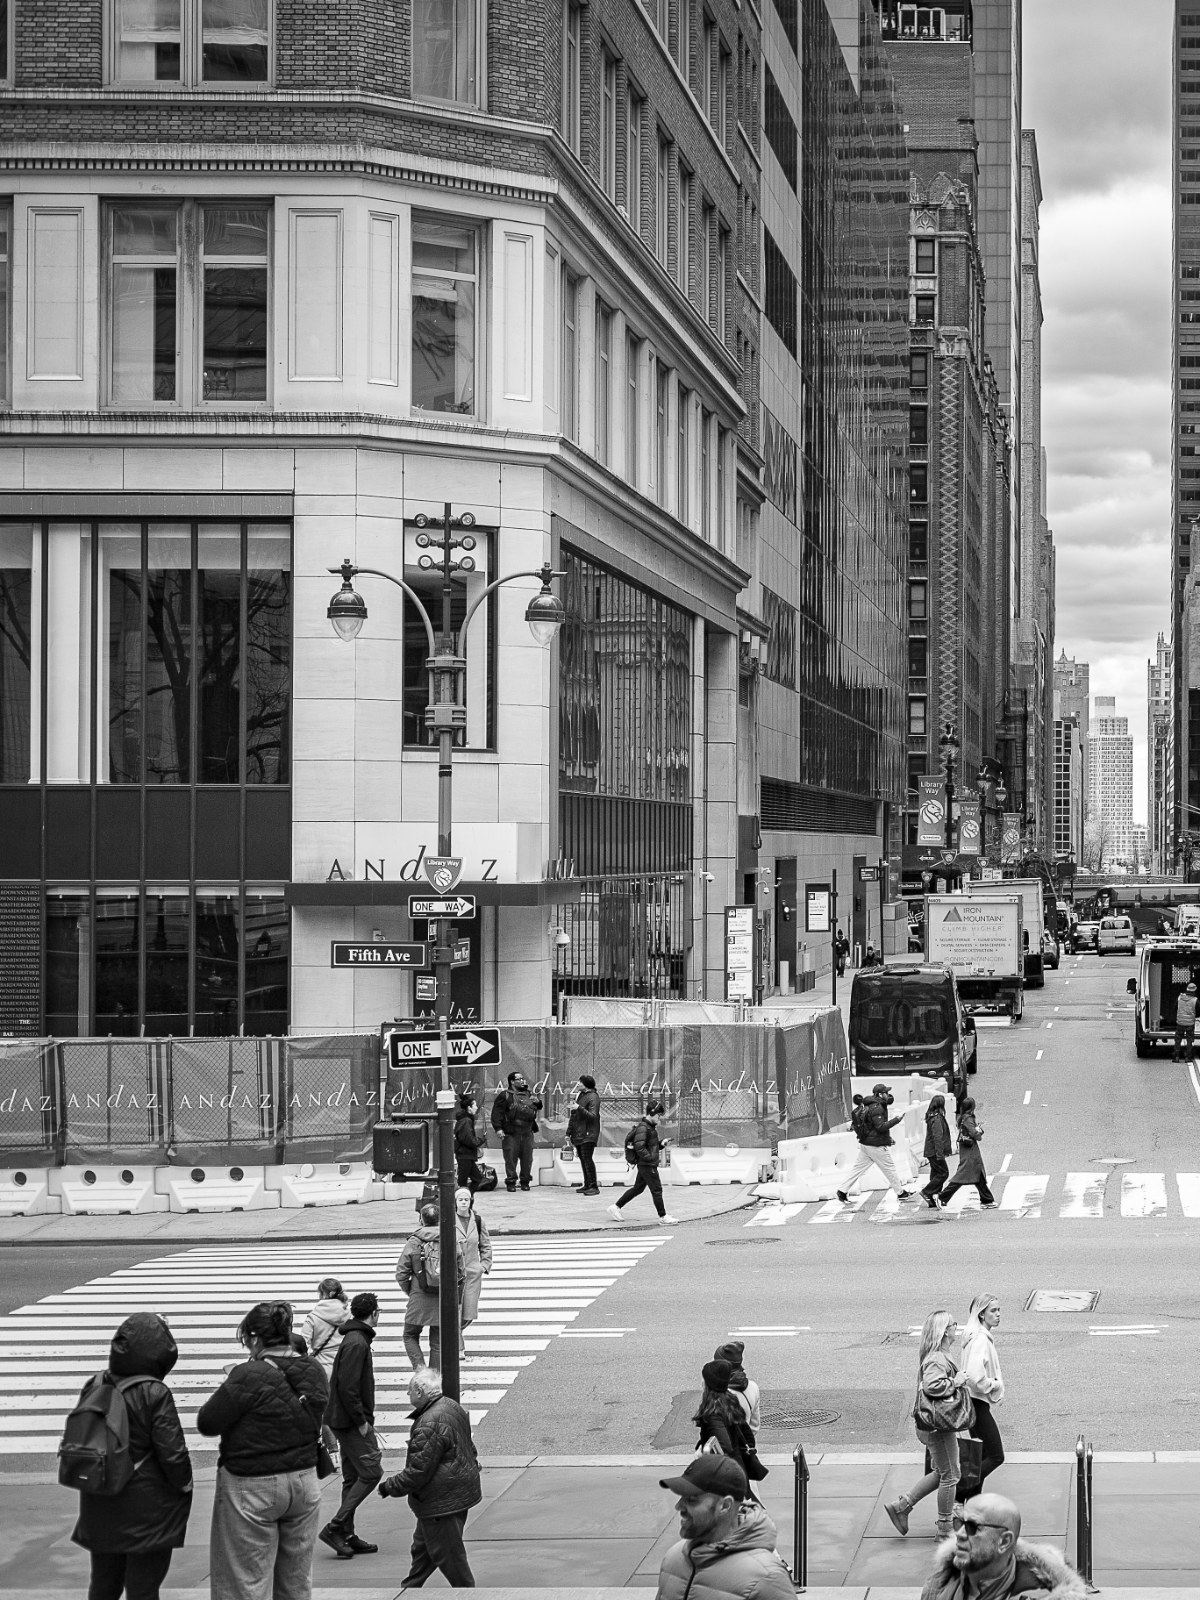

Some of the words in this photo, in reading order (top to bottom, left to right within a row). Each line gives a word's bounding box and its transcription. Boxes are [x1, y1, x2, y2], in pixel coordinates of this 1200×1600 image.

[920, 780, 944, 789] Library
[925, 787, 939, 796] Way
[427, 859, 446, 867] Library
[447, 859, 460, 868] Way
[415, 902, 434, 912] ONE
[445, 902, 466, 912] WAY
[348, 949, 381, 962] Fifth
[384, 949, 411, 962] Ave
[402, 1043, 431, 1057] ONE
[451, 1040, 481, 1055] WAY
